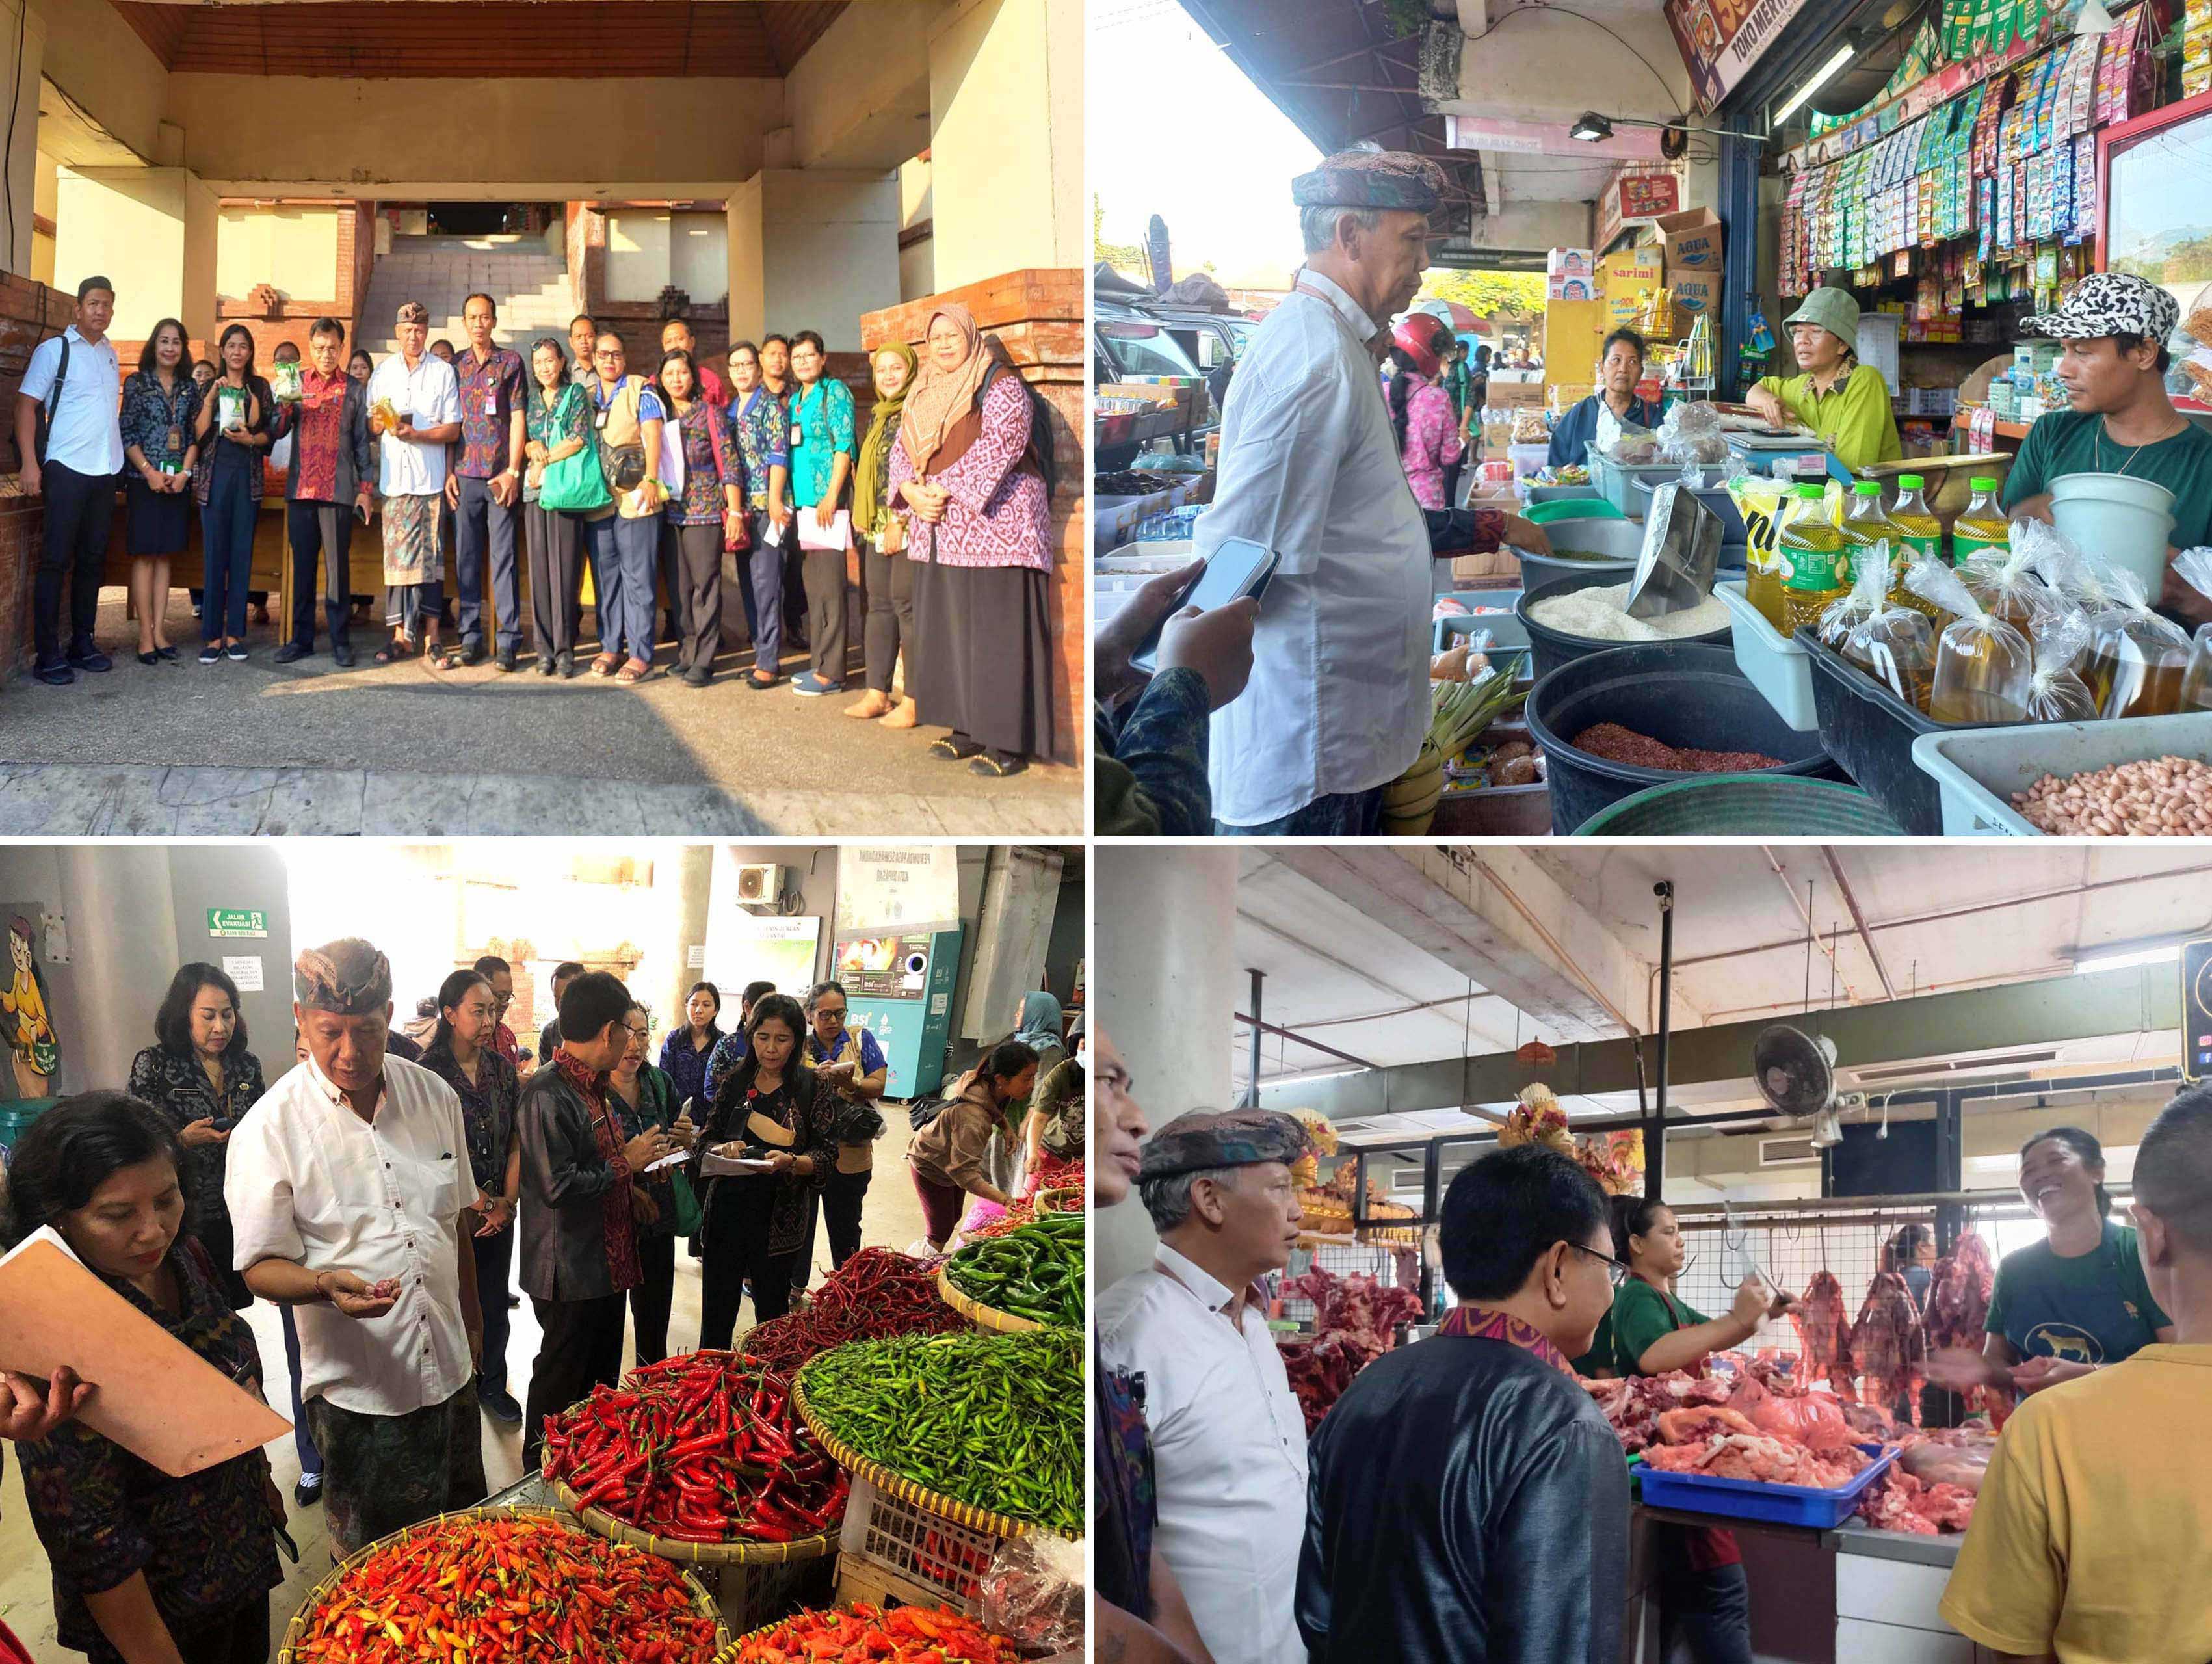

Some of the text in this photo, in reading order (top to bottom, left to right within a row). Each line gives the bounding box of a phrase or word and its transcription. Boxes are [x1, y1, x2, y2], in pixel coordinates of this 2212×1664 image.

[1731, 22, 1758, 62] TOKO
[1677, 237, 1710, 254] AQUA
[1613, 268, 1654, 278] sarimi
[1676, 282, 1708, 297] AQUA
